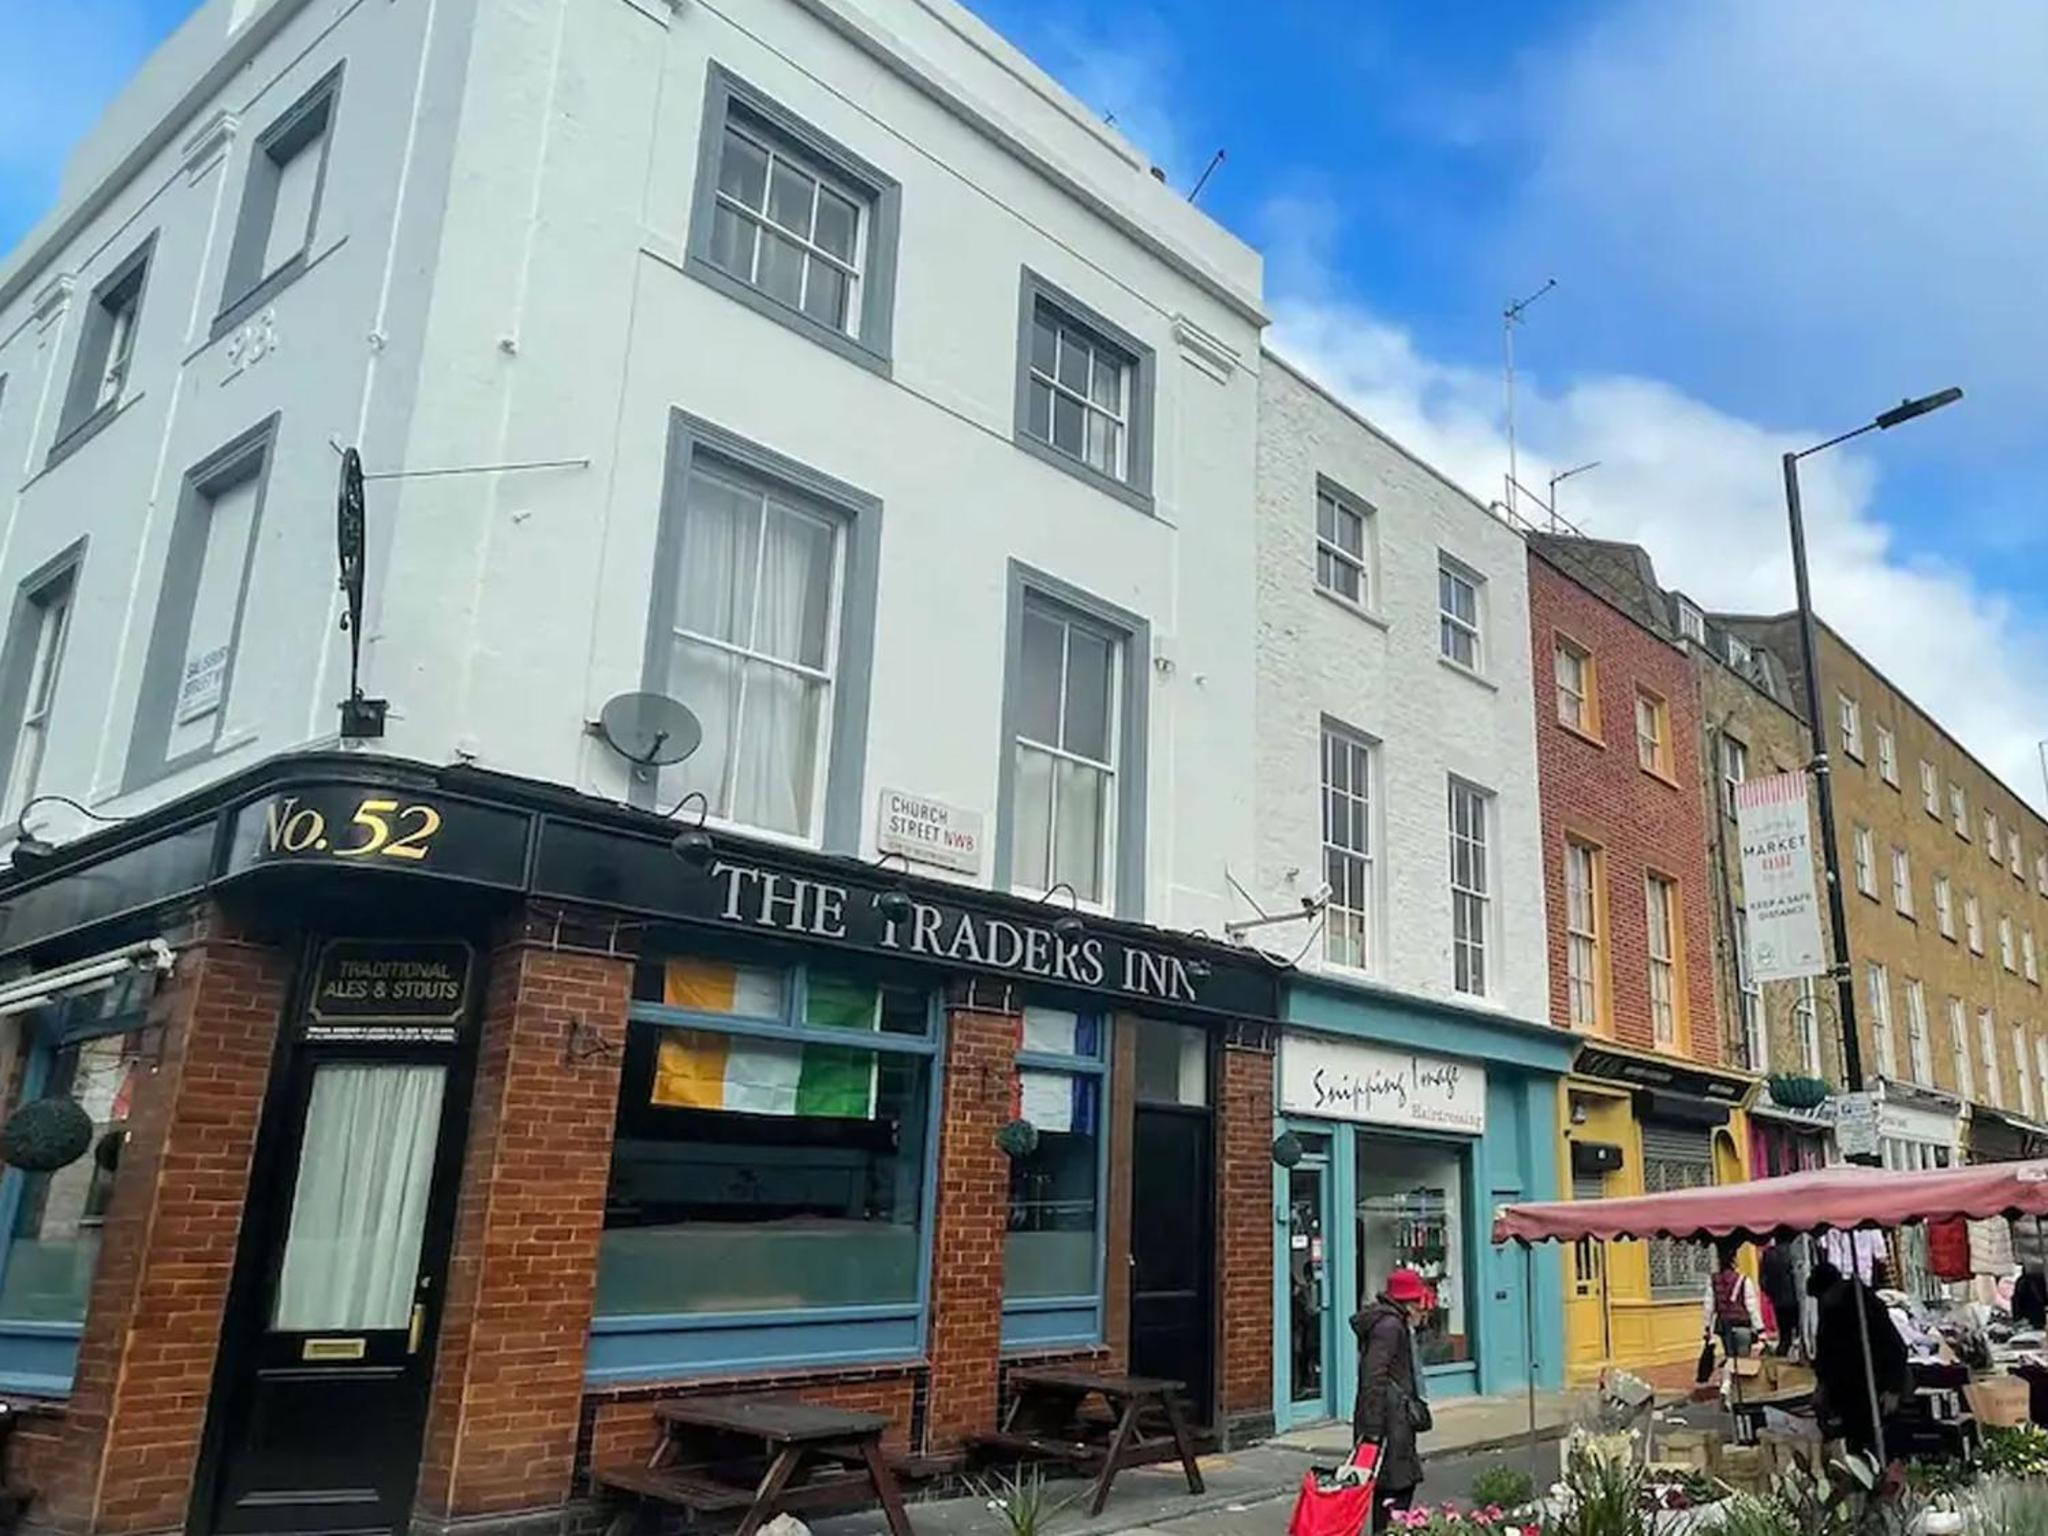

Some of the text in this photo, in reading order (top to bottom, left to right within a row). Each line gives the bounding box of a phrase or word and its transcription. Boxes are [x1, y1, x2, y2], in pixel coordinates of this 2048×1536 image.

[890, 796, 949, 825] CHURCH
[267, 797, 442, 860] No. 52
[889, 815, 975, 852] STREET NW8
[1743, 833, 1806, 859] MARKET
[1758, 905, 1805, 921] DISTANCE
[711, 860, 847, 939] THE
[1121, 946, 1198, 1001] INN
[339, 960, 451, 979] TRADITIONAL
[323, 979, 460, 999] ALES & STOUTS
[1312, 1068, 1408, 1112] Snipping
